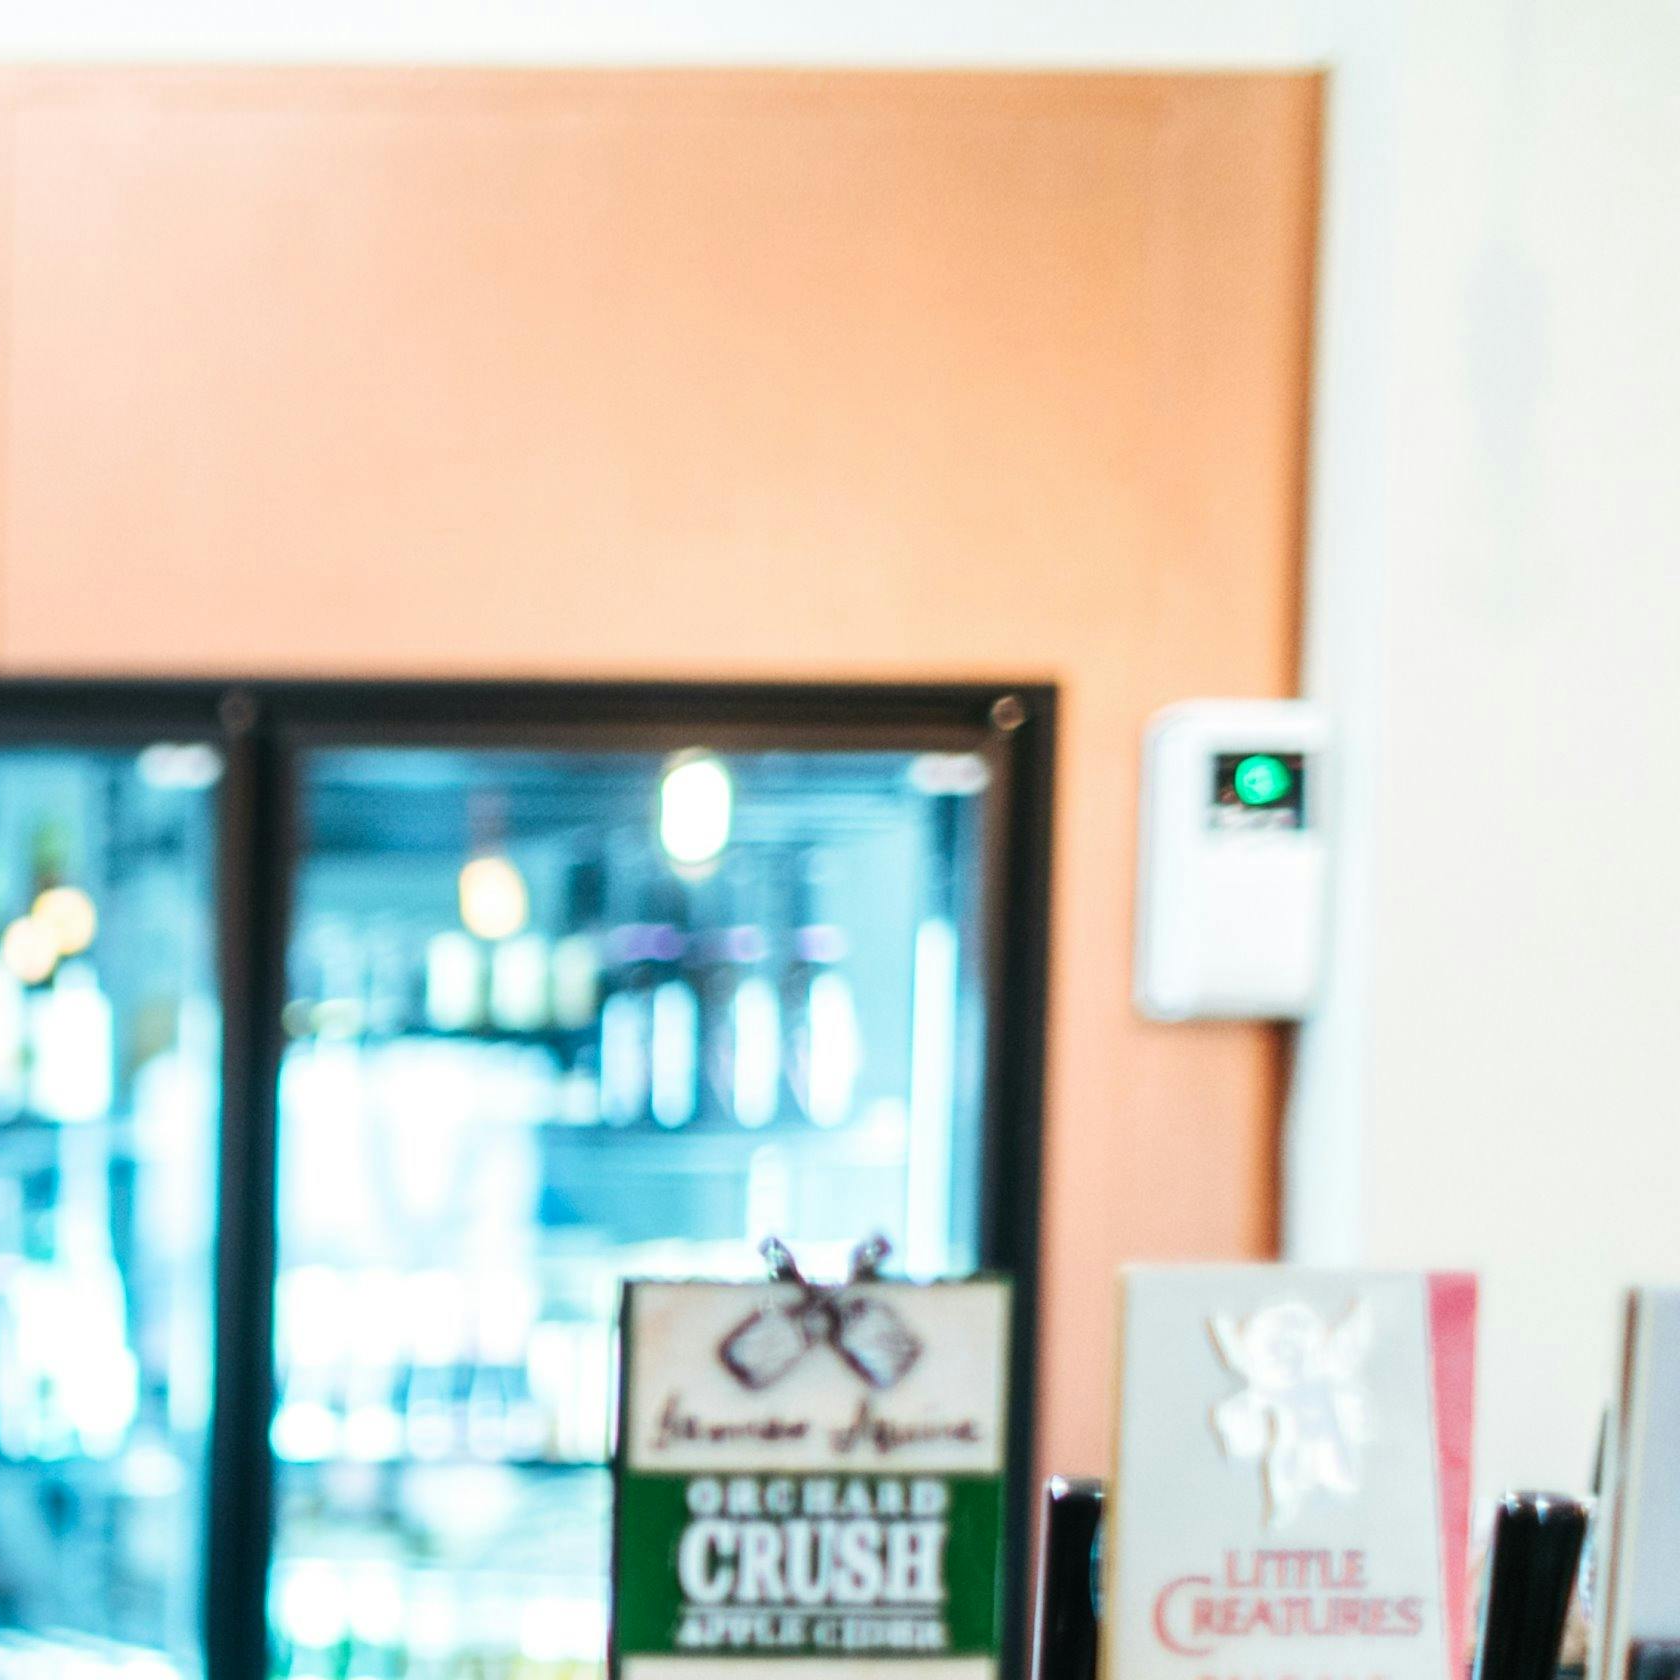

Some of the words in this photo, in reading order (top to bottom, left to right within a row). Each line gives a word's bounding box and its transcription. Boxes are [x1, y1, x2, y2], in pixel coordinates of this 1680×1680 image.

[686, 1477, 947, 1515] ORCHARD
[678, 1518, 946, 1604] CRUSH
[1223, 1549, 1368, 1590] LITTLE
[1153, 1574, 1425, 1657] CREATURES
